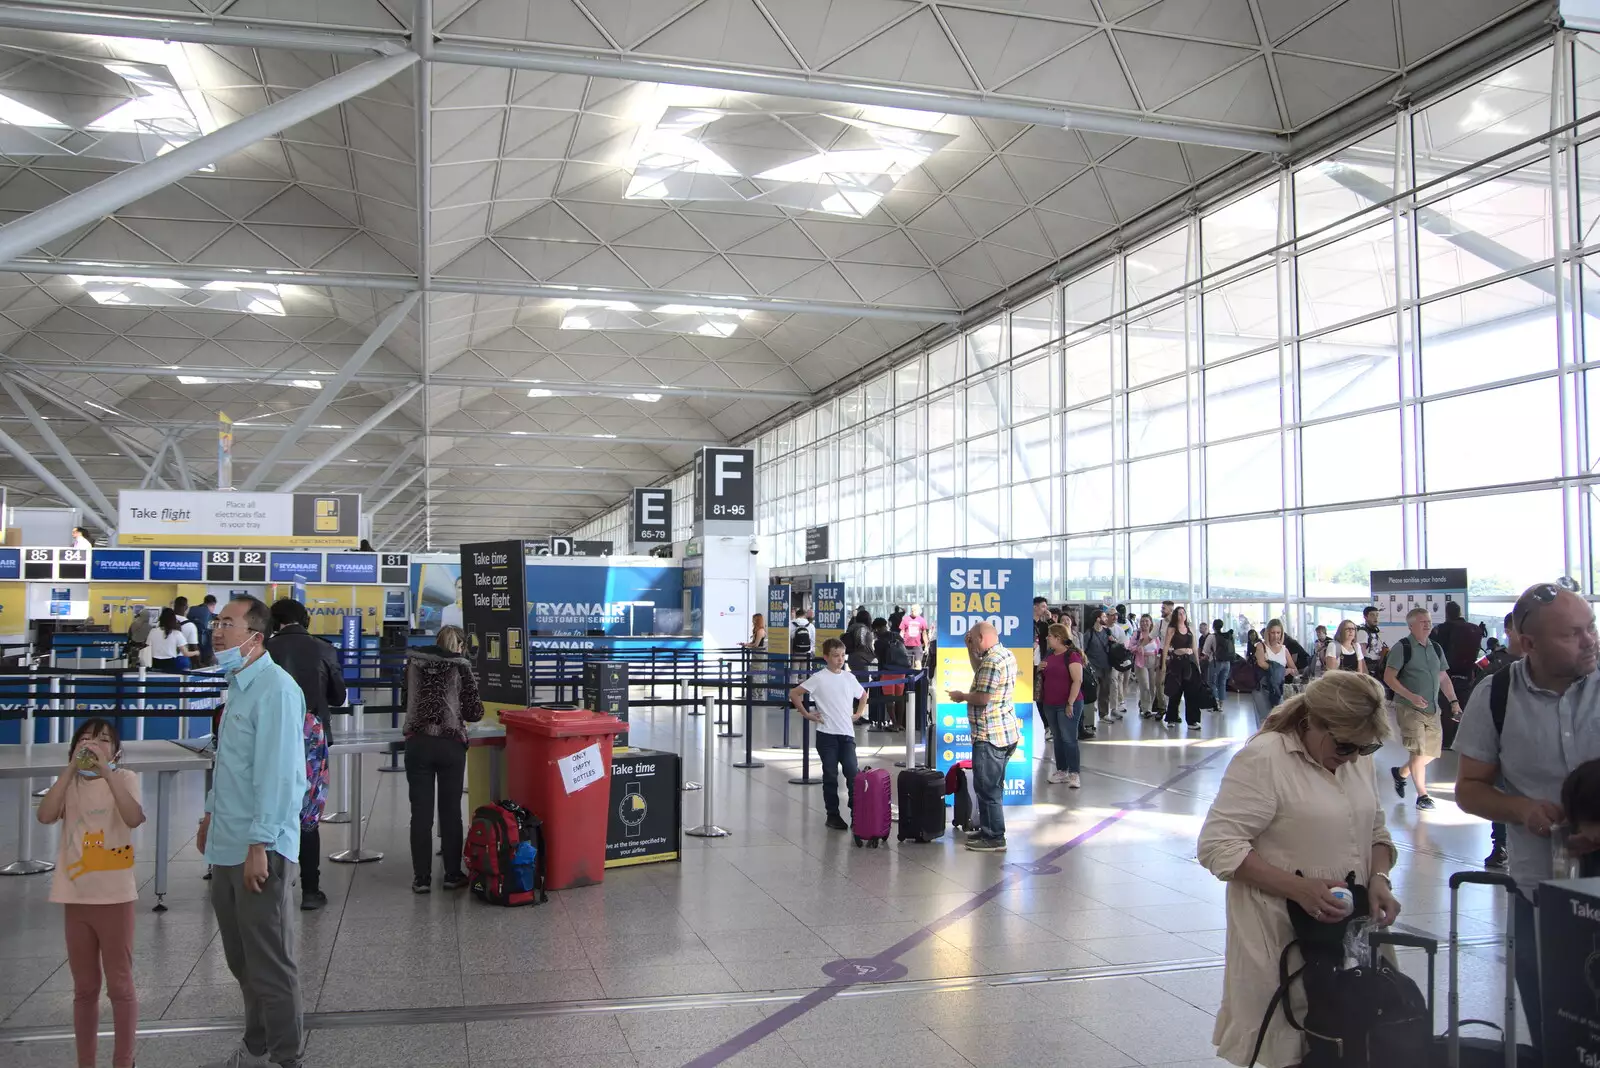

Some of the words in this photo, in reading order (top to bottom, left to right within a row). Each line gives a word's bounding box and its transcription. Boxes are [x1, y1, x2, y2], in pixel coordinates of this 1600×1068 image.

[715, 454, 744, 496] F
[226, 500, 246, 508] Place
[642, 493, 665, 525] E
[713, 504, 745, 515] 81-95
[131, 507, 157, 518] Take
[161, 508, 191, 521] flight
[641, 531, 666, 539] 65-79
[553, 538, 571, 555] D
[31, 549, 48, 561] 85
[64, 549, 82, 561] 84
[212, 552, 229, 563] 83
[244, 552, 261, 563] 82
[387, 554, 401, 566] 81
[473, 552, 490, 565] Take
[491, 551, 508, 564] time
[474, 572, 491, 585] Take
[492, 575, 508, 585] care
[949, 568, 1012, 590] SELF
[770, 590, 785, 600] SELF
[818, 588, 839, 599] SELF
[473, 593, 490, 606] Take
[491, 592, 511, 609] flight
[770, 601, 783, 610] BAG
[818, 600, 834, 611] BAG
[949, 592, 1001, 613] BAG
[306, 607, 363, 616] YANAIR
[535, 602, 625, 616] RYANAIR
[770, 612, 787, 621] DROP
[818, 612, 841, 623] DROP
[532, 641, 594, 649] RYANAIR
[572, 751, 587, 761] ONLY
[572, 760, 591, 772] EMPTY
[611, 763, 633, 775] Take
[635, 762, 656, 773] time
[573, 769, 596, 784] BOTTLES
[640, 837, 659, 846] specified
[620, 848, 632, 856] your
